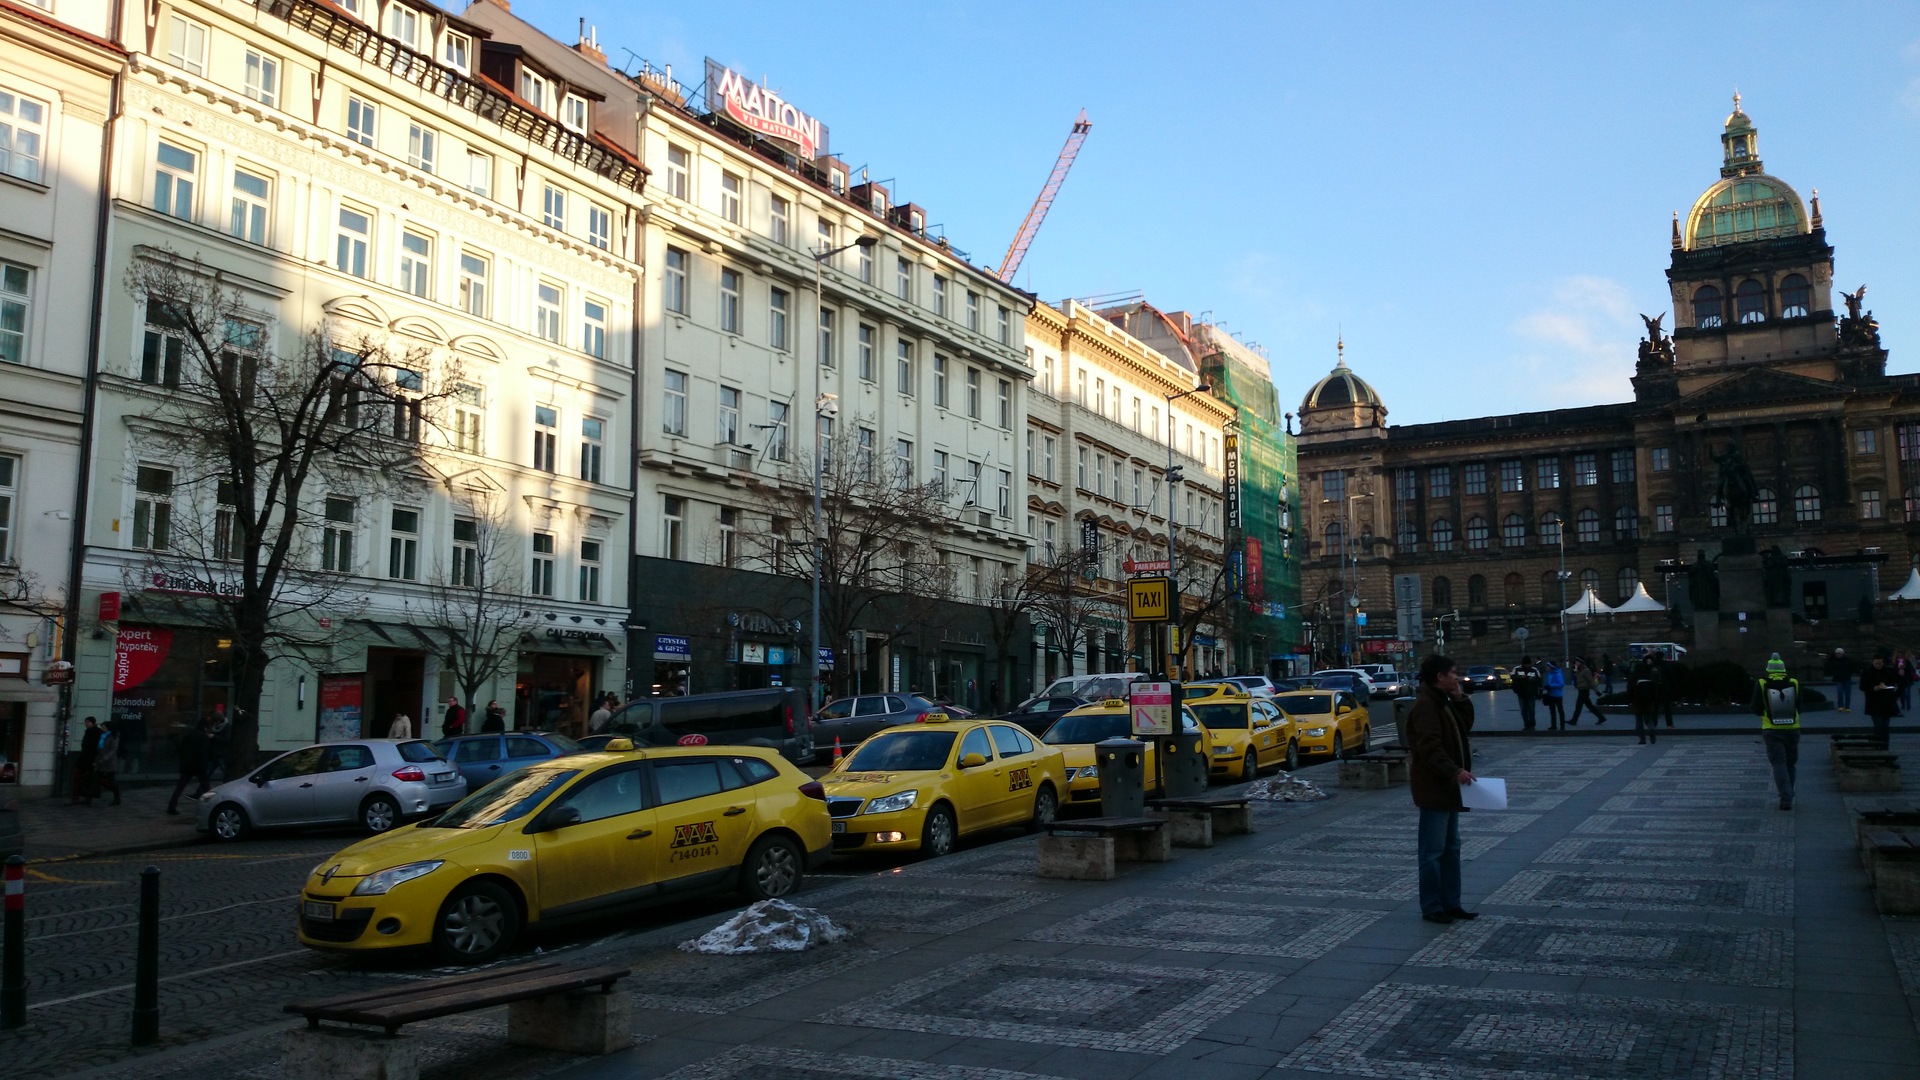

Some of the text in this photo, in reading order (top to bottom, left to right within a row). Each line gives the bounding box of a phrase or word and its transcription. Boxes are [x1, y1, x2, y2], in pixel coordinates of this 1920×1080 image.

[718, 68, 821, 150] MATTONI
[743, 114, 804, 143] VIS NATURAE
[1227, 451, 1239, 527] McDonald's
[1134, 561, 1169, 571] FAIR PLACE
[220, 581, 244, 596] Bank
[1136, 592, 1161, 608] TAXI
[547, 628, 605, 641] CALZEDONIA
[658, 637, 688, 645] CRYSTAL
[119, 641, 159, 653] hypotéky
[116, 652, 130, 686] půjčky
[113, 698, 156, 707] Jednoduše
[121, 712, 142, 720] méně
[1009, 768, 1033, 792] AAA
[670, 820, 719, 849] AAA
[512, 850, 528, 859] 0800
